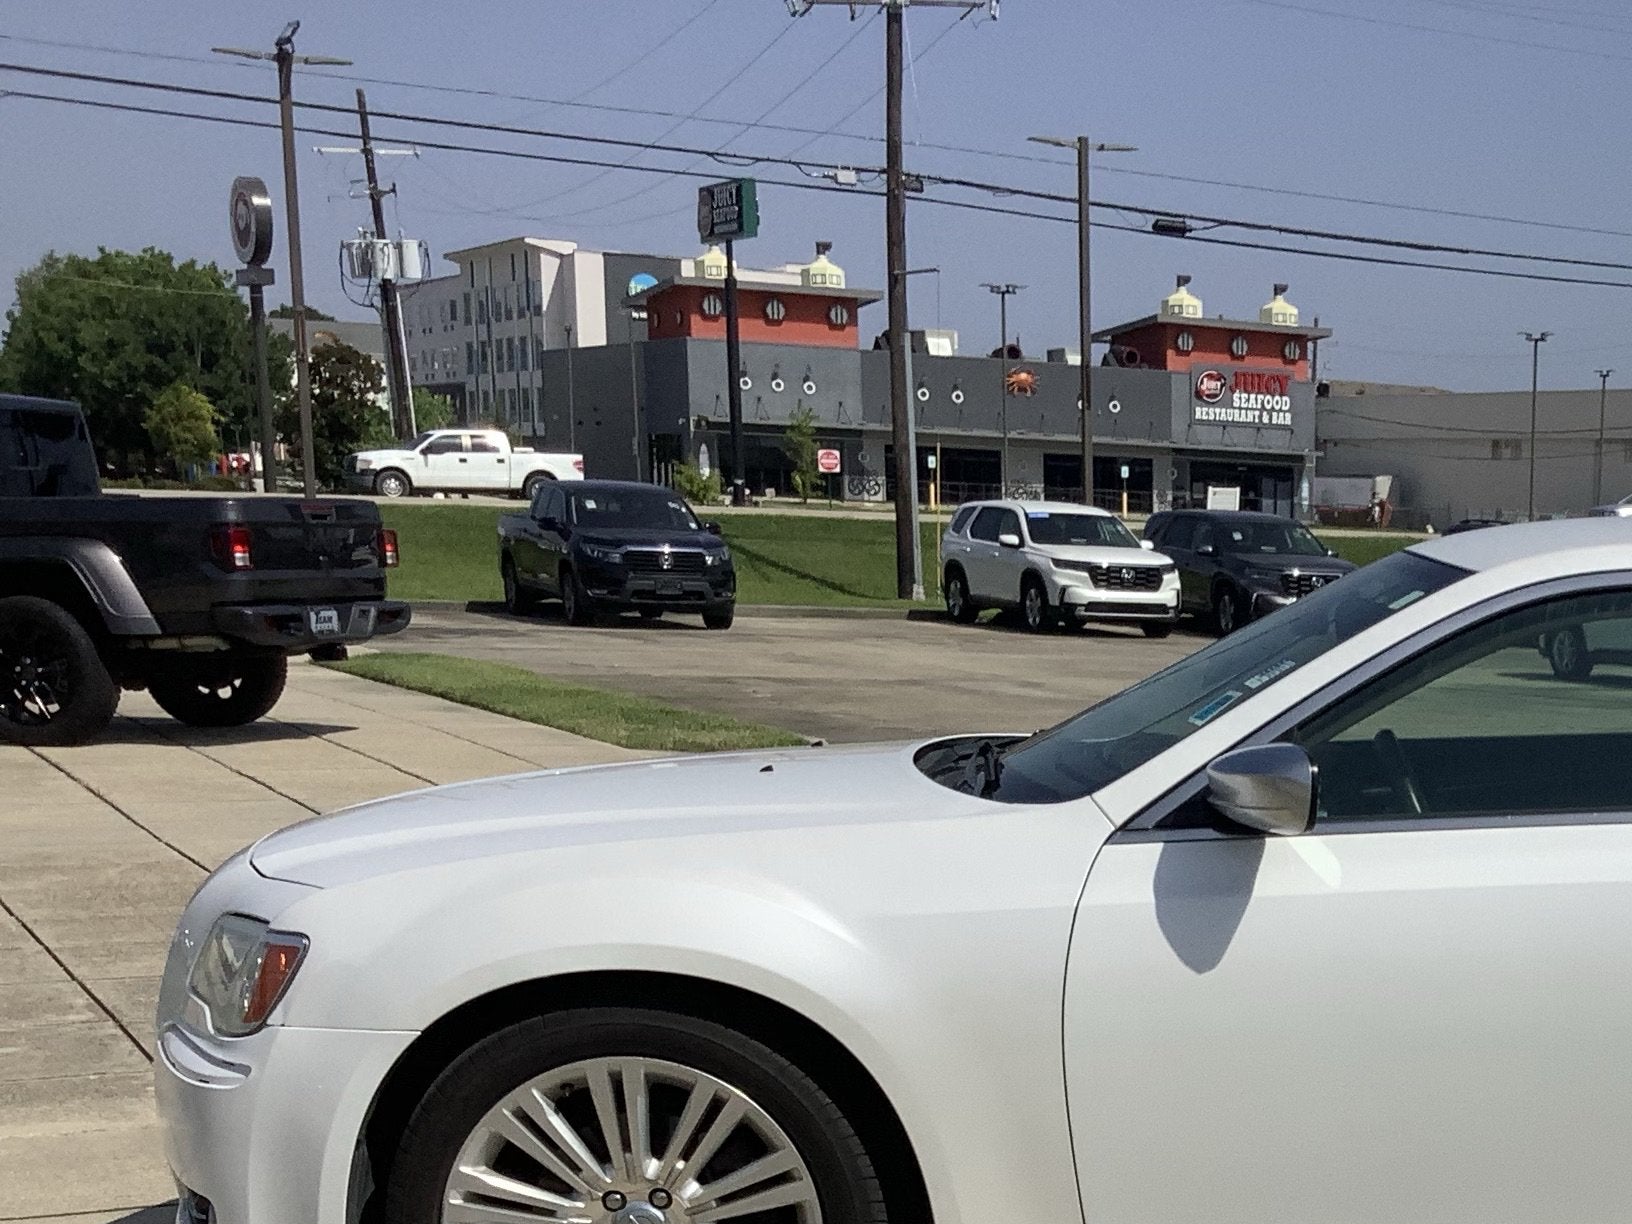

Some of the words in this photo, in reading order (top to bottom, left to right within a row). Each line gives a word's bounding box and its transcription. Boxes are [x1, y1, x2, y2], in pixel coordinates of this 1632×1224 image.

[1230, 372, 1290, 394] JUICY
[1233, 391, 1291, 410] SEAFOOD
[1195, 407, 1259, 423] RESTAURANT
[1262, 411, 1270, 424] &
[1271, 411, 1293, 426] BAR
